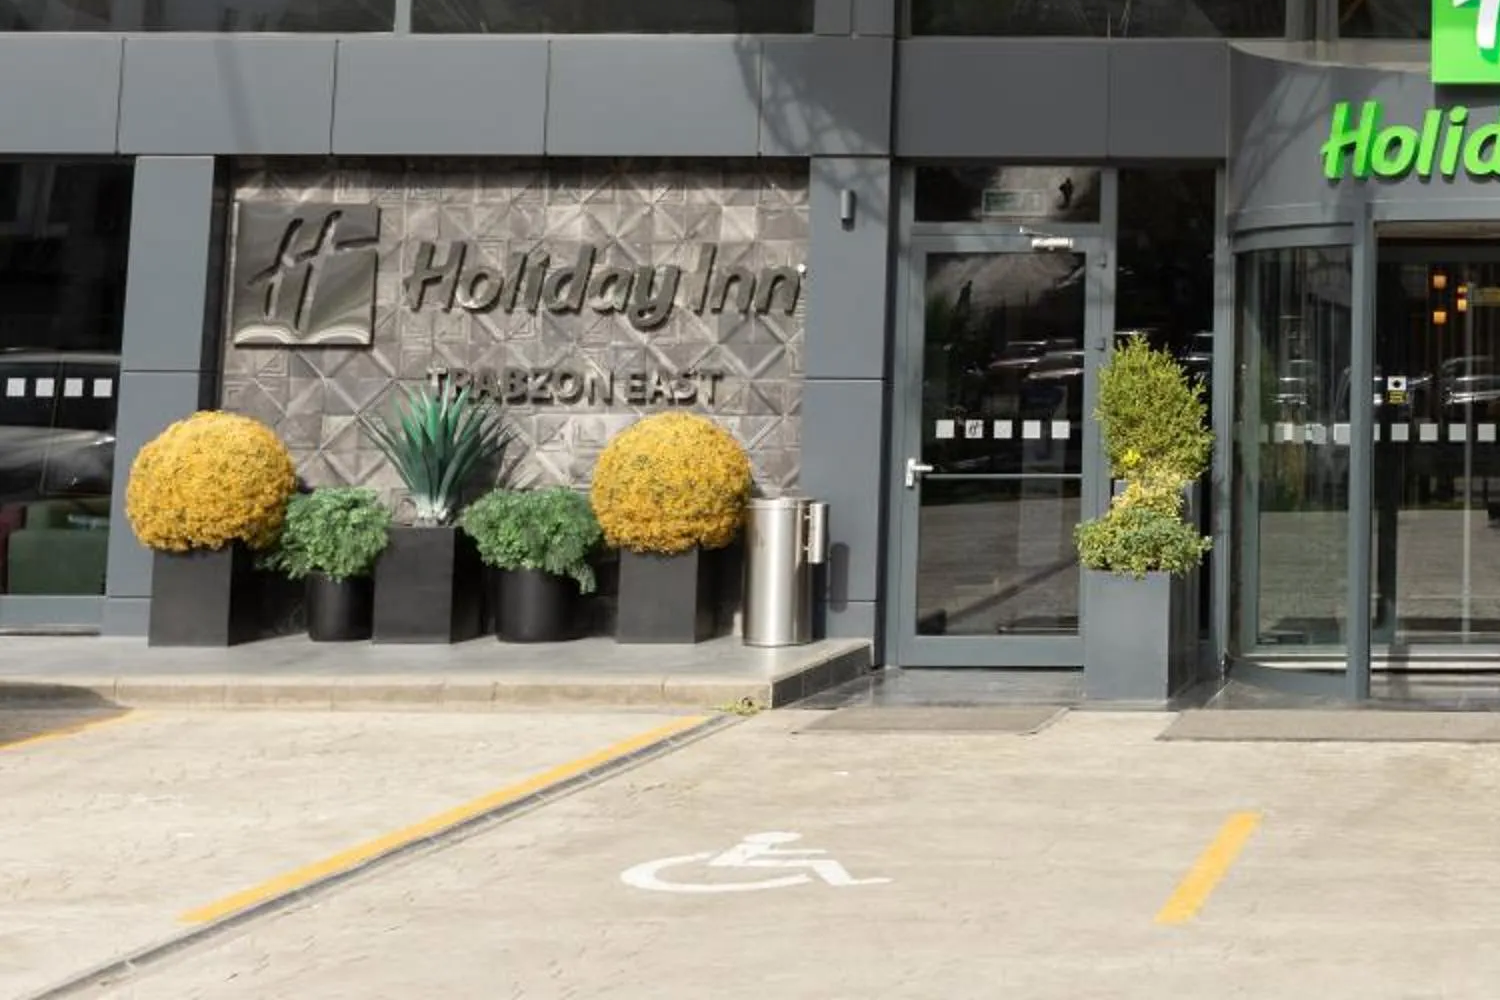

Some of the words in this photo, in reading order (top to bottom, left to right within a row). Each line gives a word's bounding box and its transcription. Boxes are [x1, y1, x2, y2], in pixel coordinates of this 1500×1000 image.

[403, 240, 681, 332] Holiday
[695, 241, 804, 316] Inn
[426, 366, 615, 407] TRABZON
[625, 366, 725, 407] EAST
